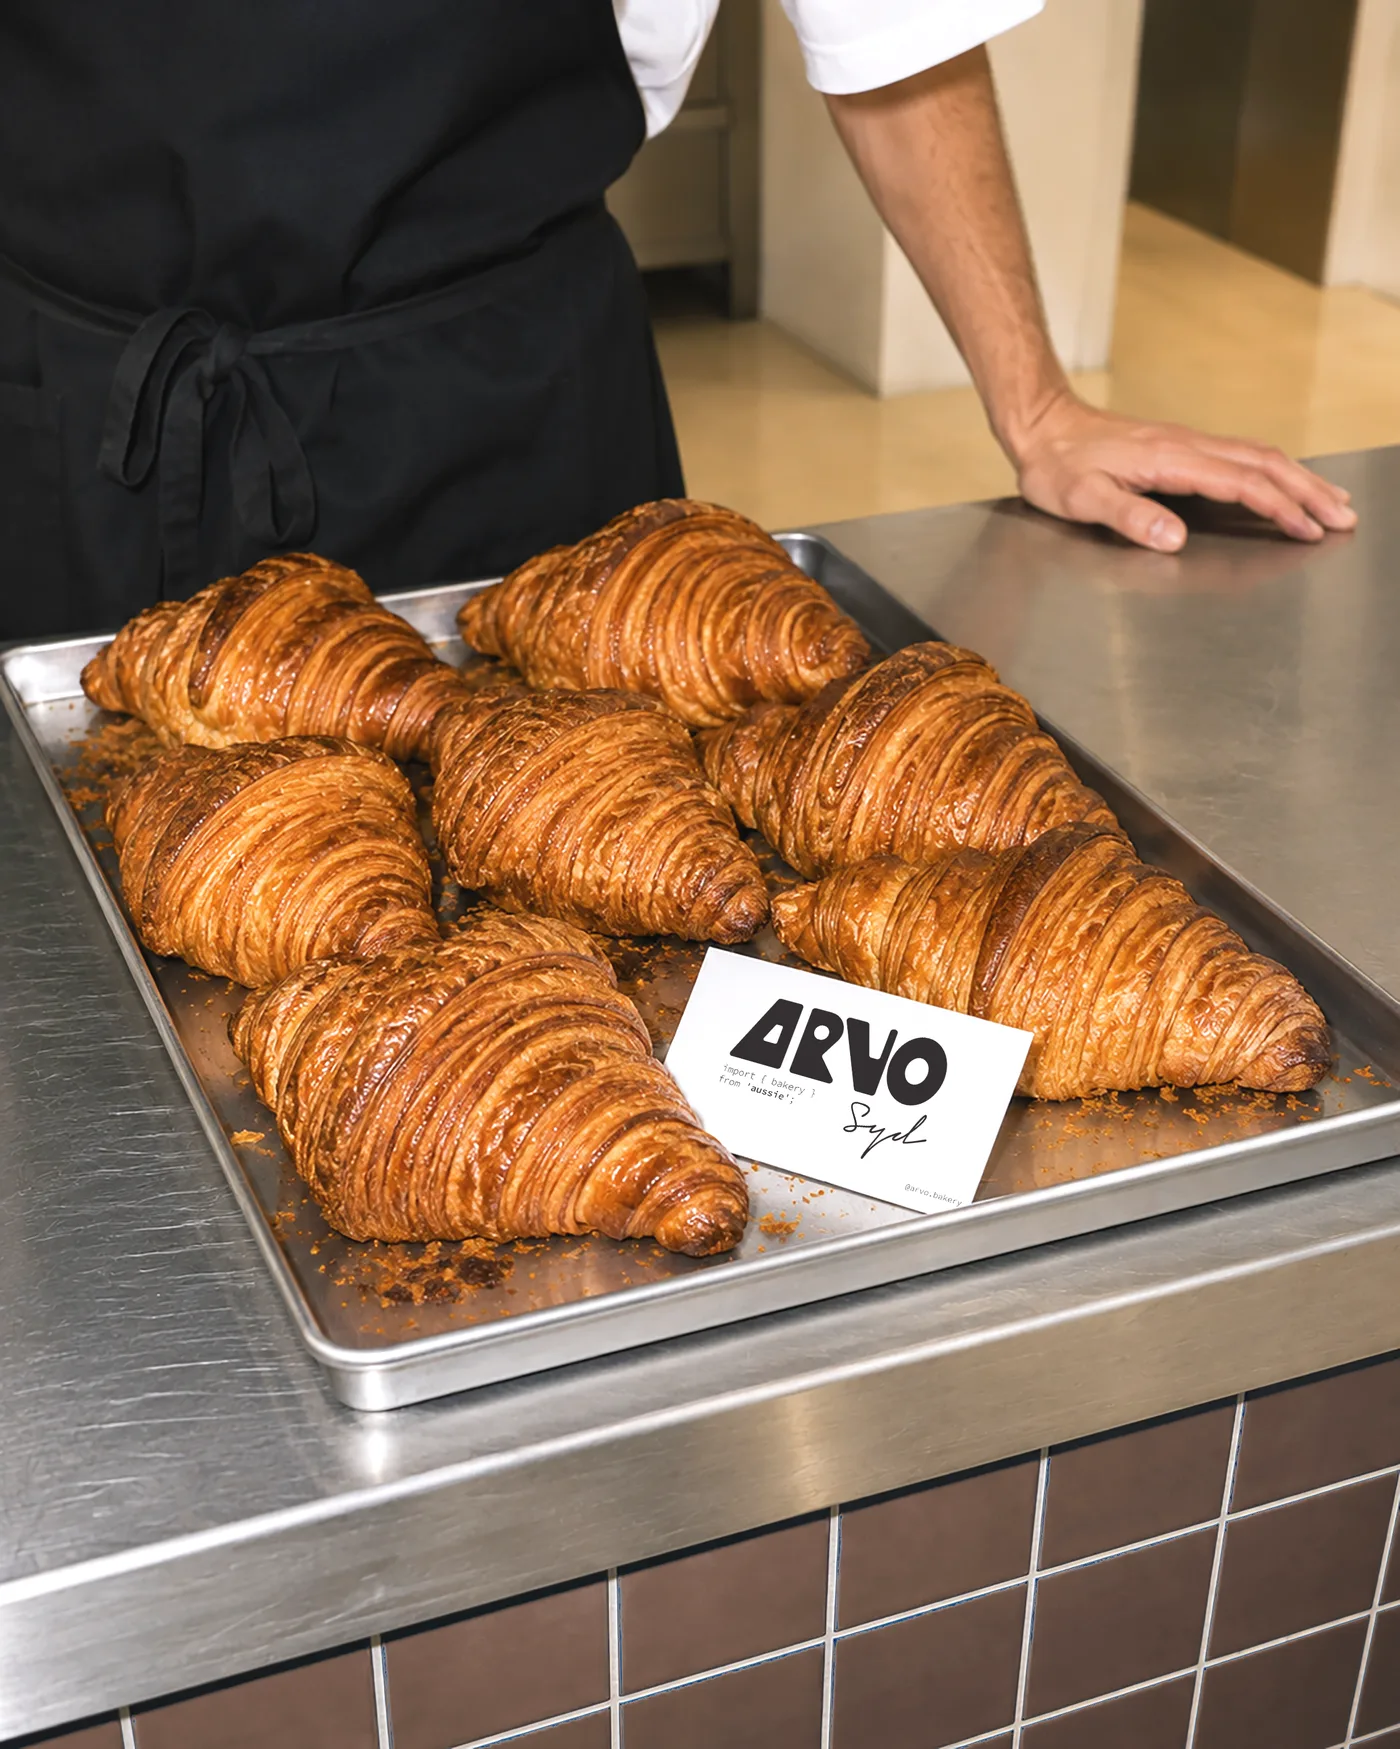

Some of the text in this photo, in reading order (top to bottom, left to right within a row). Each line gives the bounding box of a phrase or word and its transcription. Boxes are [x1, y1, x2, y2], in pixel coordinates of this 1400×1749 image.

[729, 998, 948, 1106] ARVO
[719, 1074, 741, 1088] from
[723, 1063, 756, 1081] import
[770, 1077, 806, 1096] bakery
[843, 1101, 928, 1160] Syd
[904, 1183, 963, 1208] @arvo.bakery
